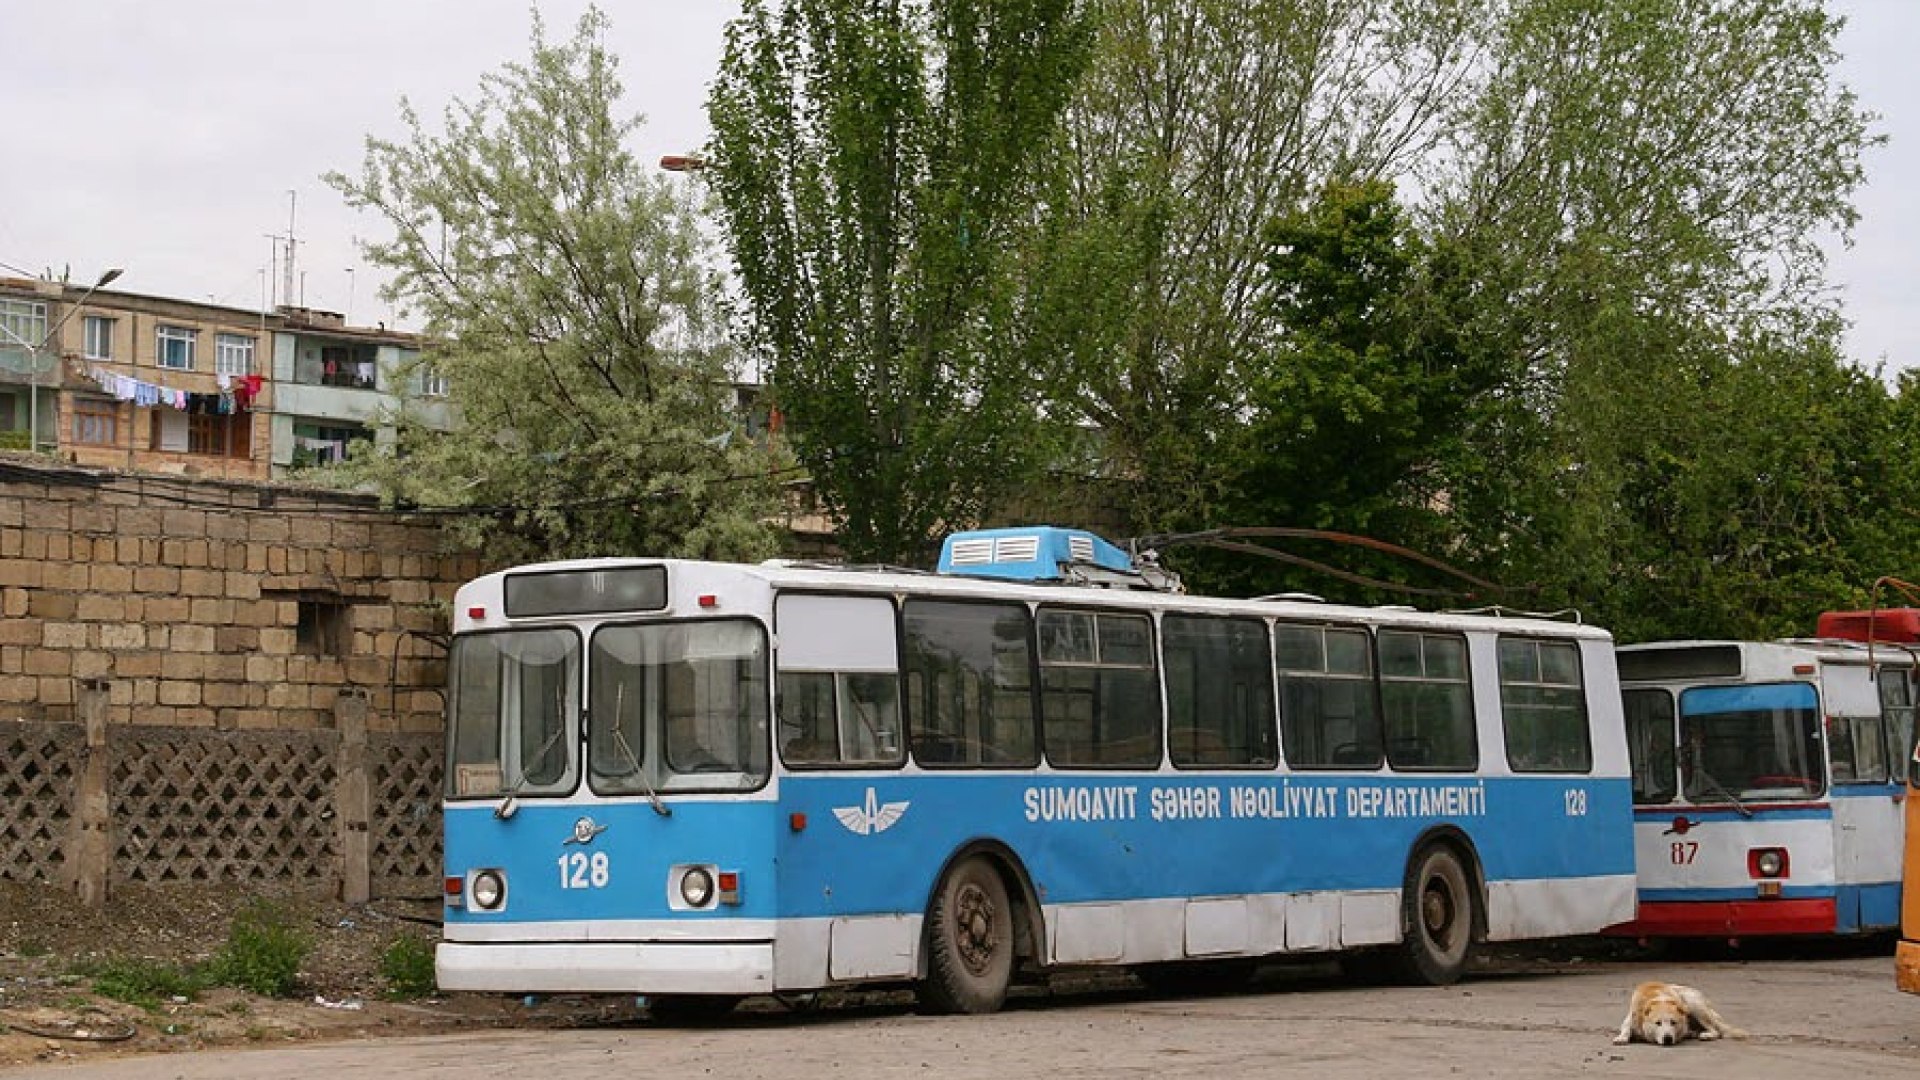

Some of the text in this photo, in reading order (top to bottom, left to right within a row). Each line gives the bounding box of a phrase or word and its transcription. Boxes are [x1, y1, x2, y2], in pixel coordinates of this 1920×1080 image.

[1024, 787, 1137, 822] SUMQAYIT
[1230, 779, 1338, 819] NƏQLİYYAT
[1346, 779, 1486, 817] DEPARTAMENTİ
[1565, 789, 1587, 816] 128
[1671, 842, 1699, 865] 87
[559, 852, 609, 889] 128
